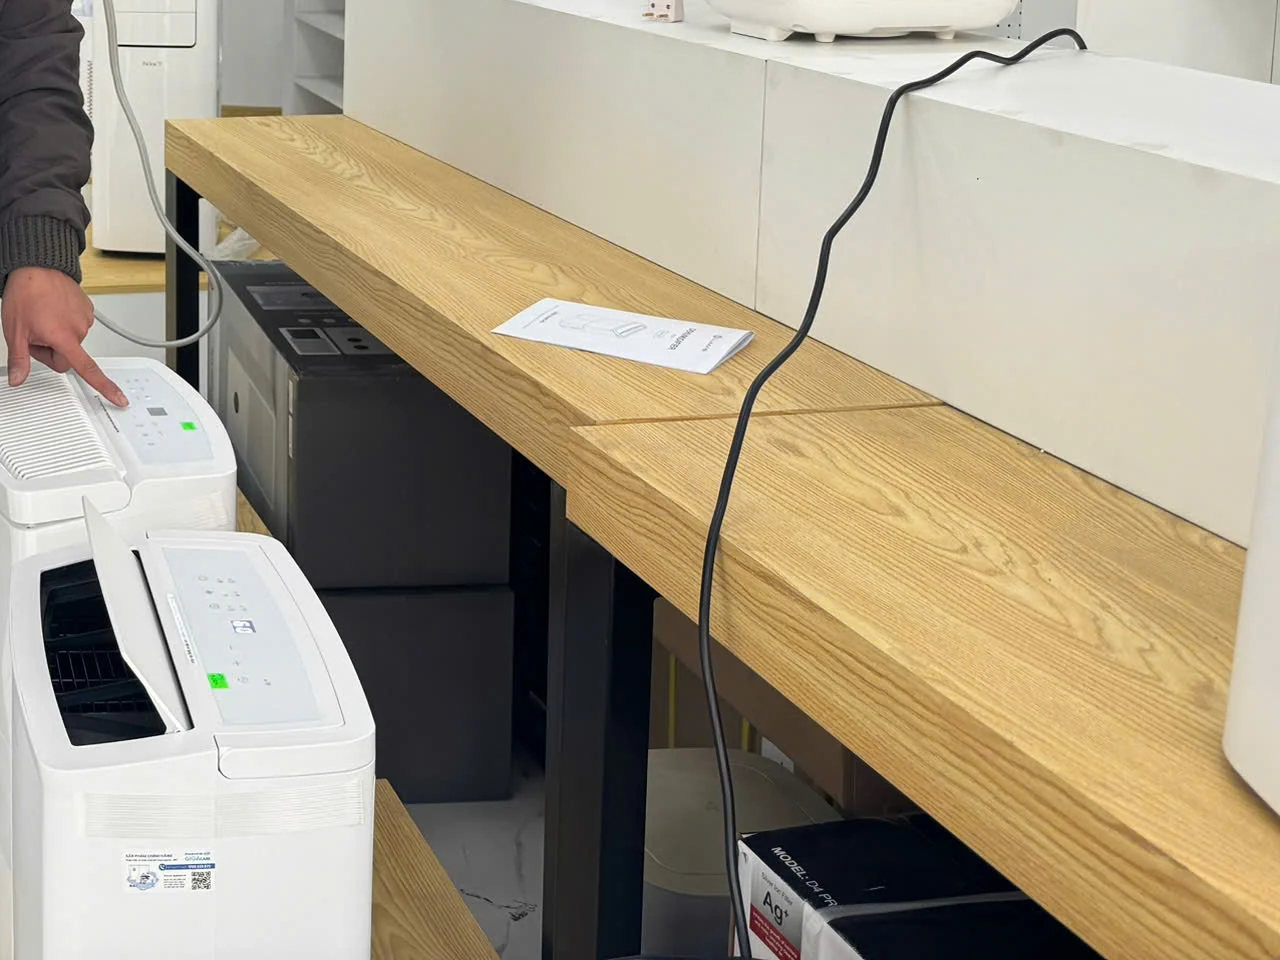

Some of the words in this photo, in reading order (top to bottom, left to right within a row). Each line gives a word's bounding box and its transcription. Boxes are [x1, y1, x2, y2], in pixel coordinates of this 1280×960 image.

[772, 847, 808, 880] MODEL:
[806, 880, 824, 892] D4
[818, 894, 838, 906] PR
